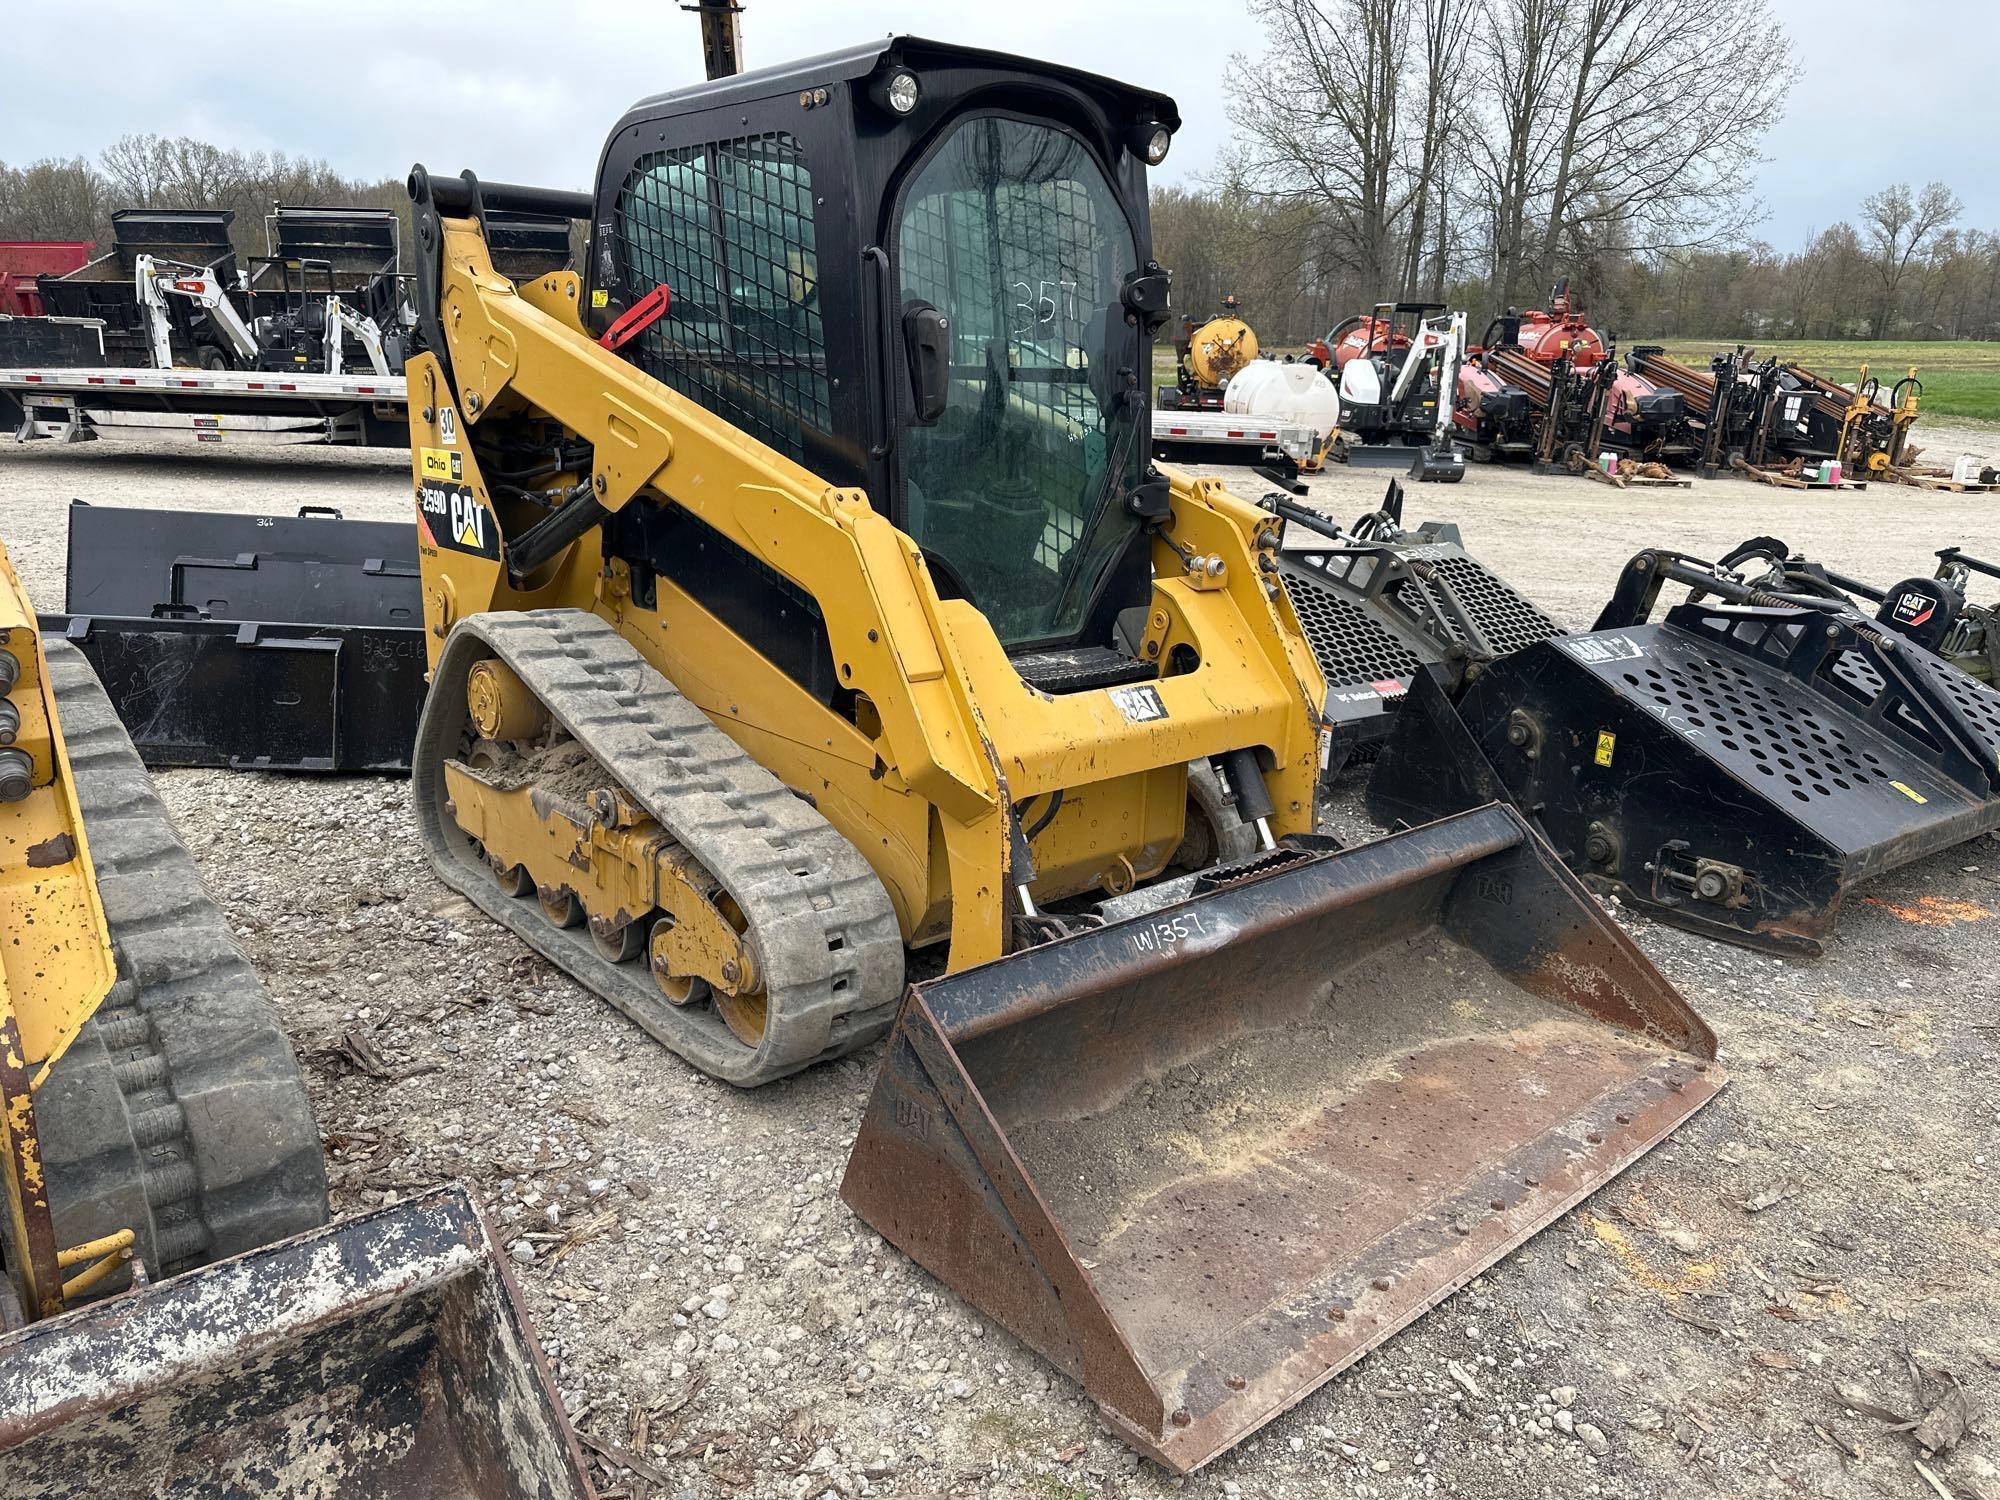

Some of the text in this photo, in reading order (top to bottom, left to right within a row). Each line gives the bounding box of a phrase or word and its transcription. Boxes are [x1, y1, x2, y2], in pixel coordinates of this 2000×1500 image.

[1013, 280, 1077, 334] 357
[440, 408, 455, 435] 30
[427, 456, 446, 471] Ohio
[422, 488, 447, 515] 259D
[450, 492, 485, 549] CAT
[1902, 593, 1927, 611] CAT
[1646, 704, 1706, 740] ACE
[1132, 912, 1206, 951] W/357
